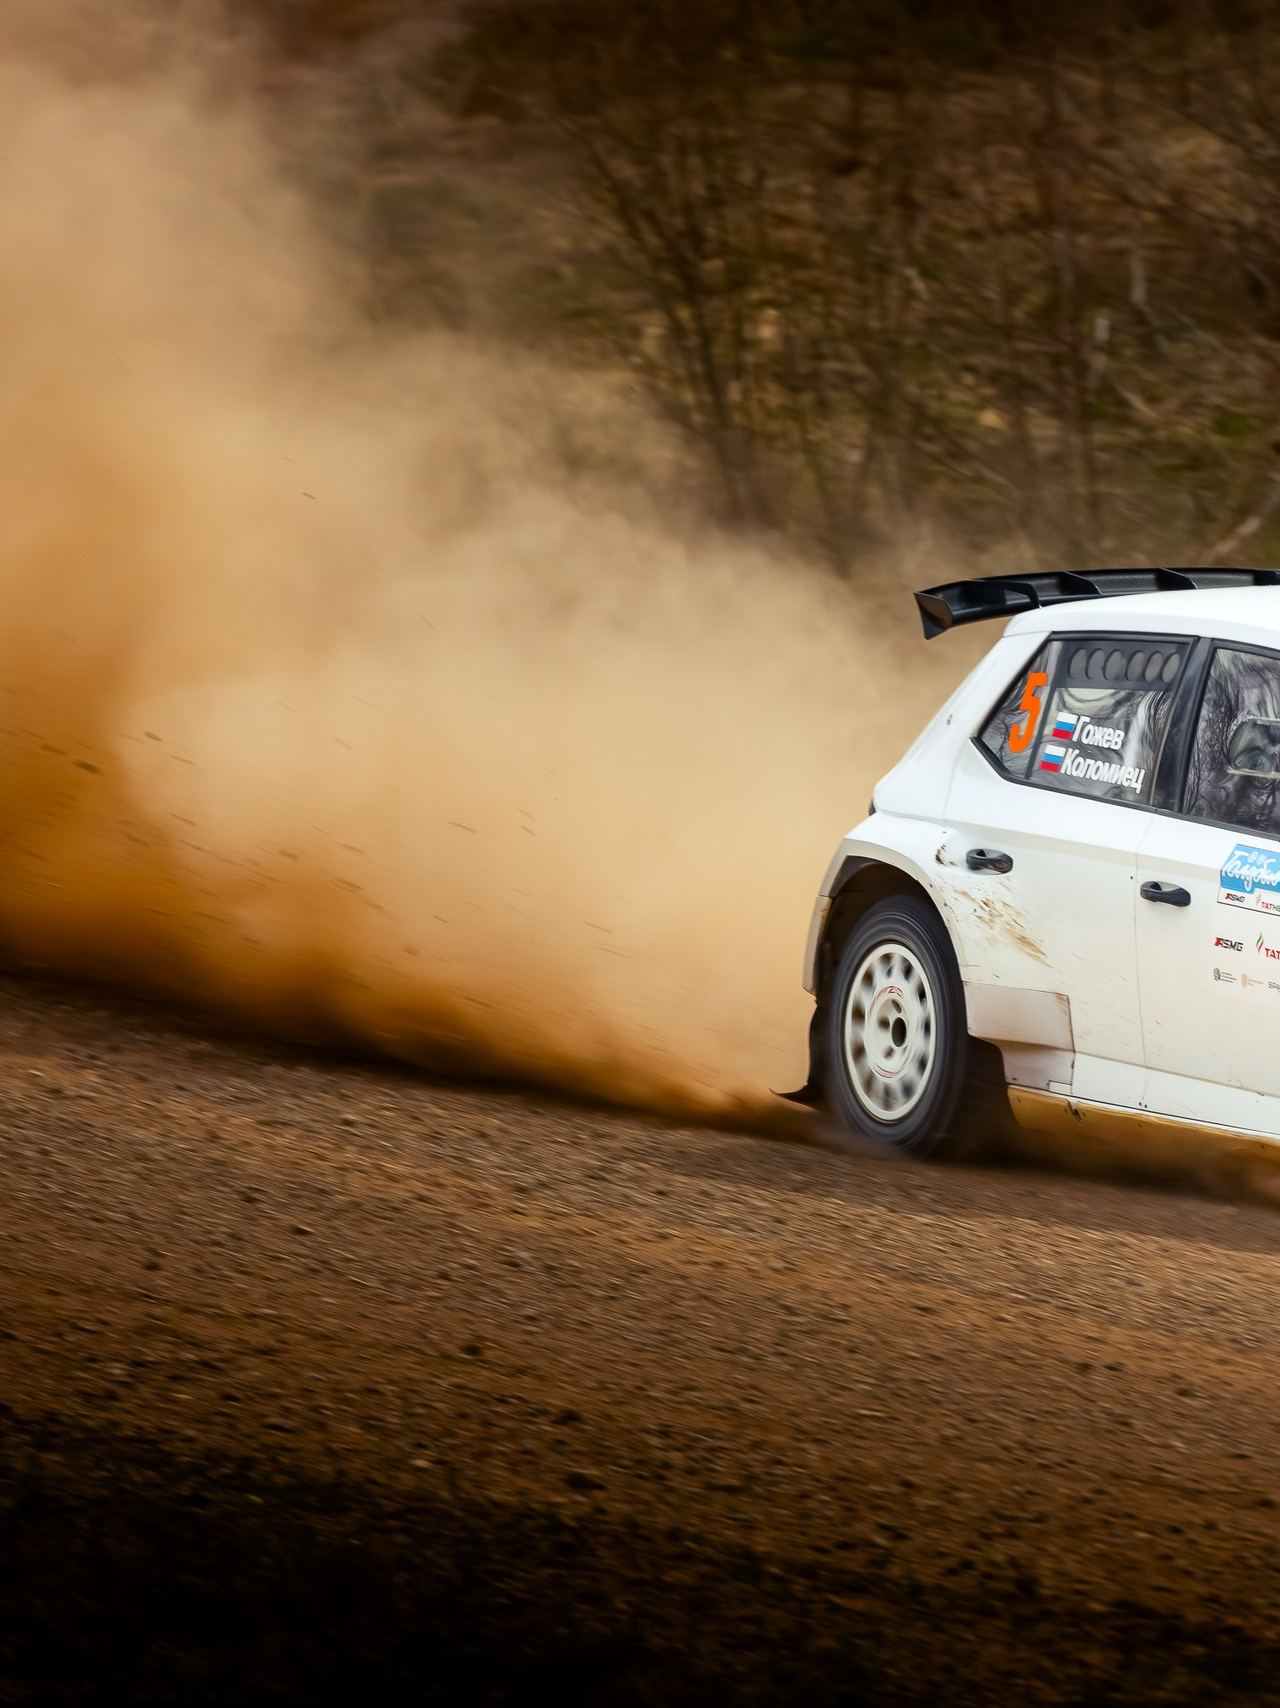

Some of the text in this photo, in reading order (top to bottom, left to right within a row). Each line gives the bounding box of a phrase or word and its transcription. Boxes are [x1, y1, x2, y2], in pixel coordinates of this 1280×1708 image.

[1008, 672, 1048, 753] 5
[1072, 715, 1125, 751] Гожев
[1060, 748, 1146, 794] Коломиец
[1215, 936, 1243, 952] RSMG
